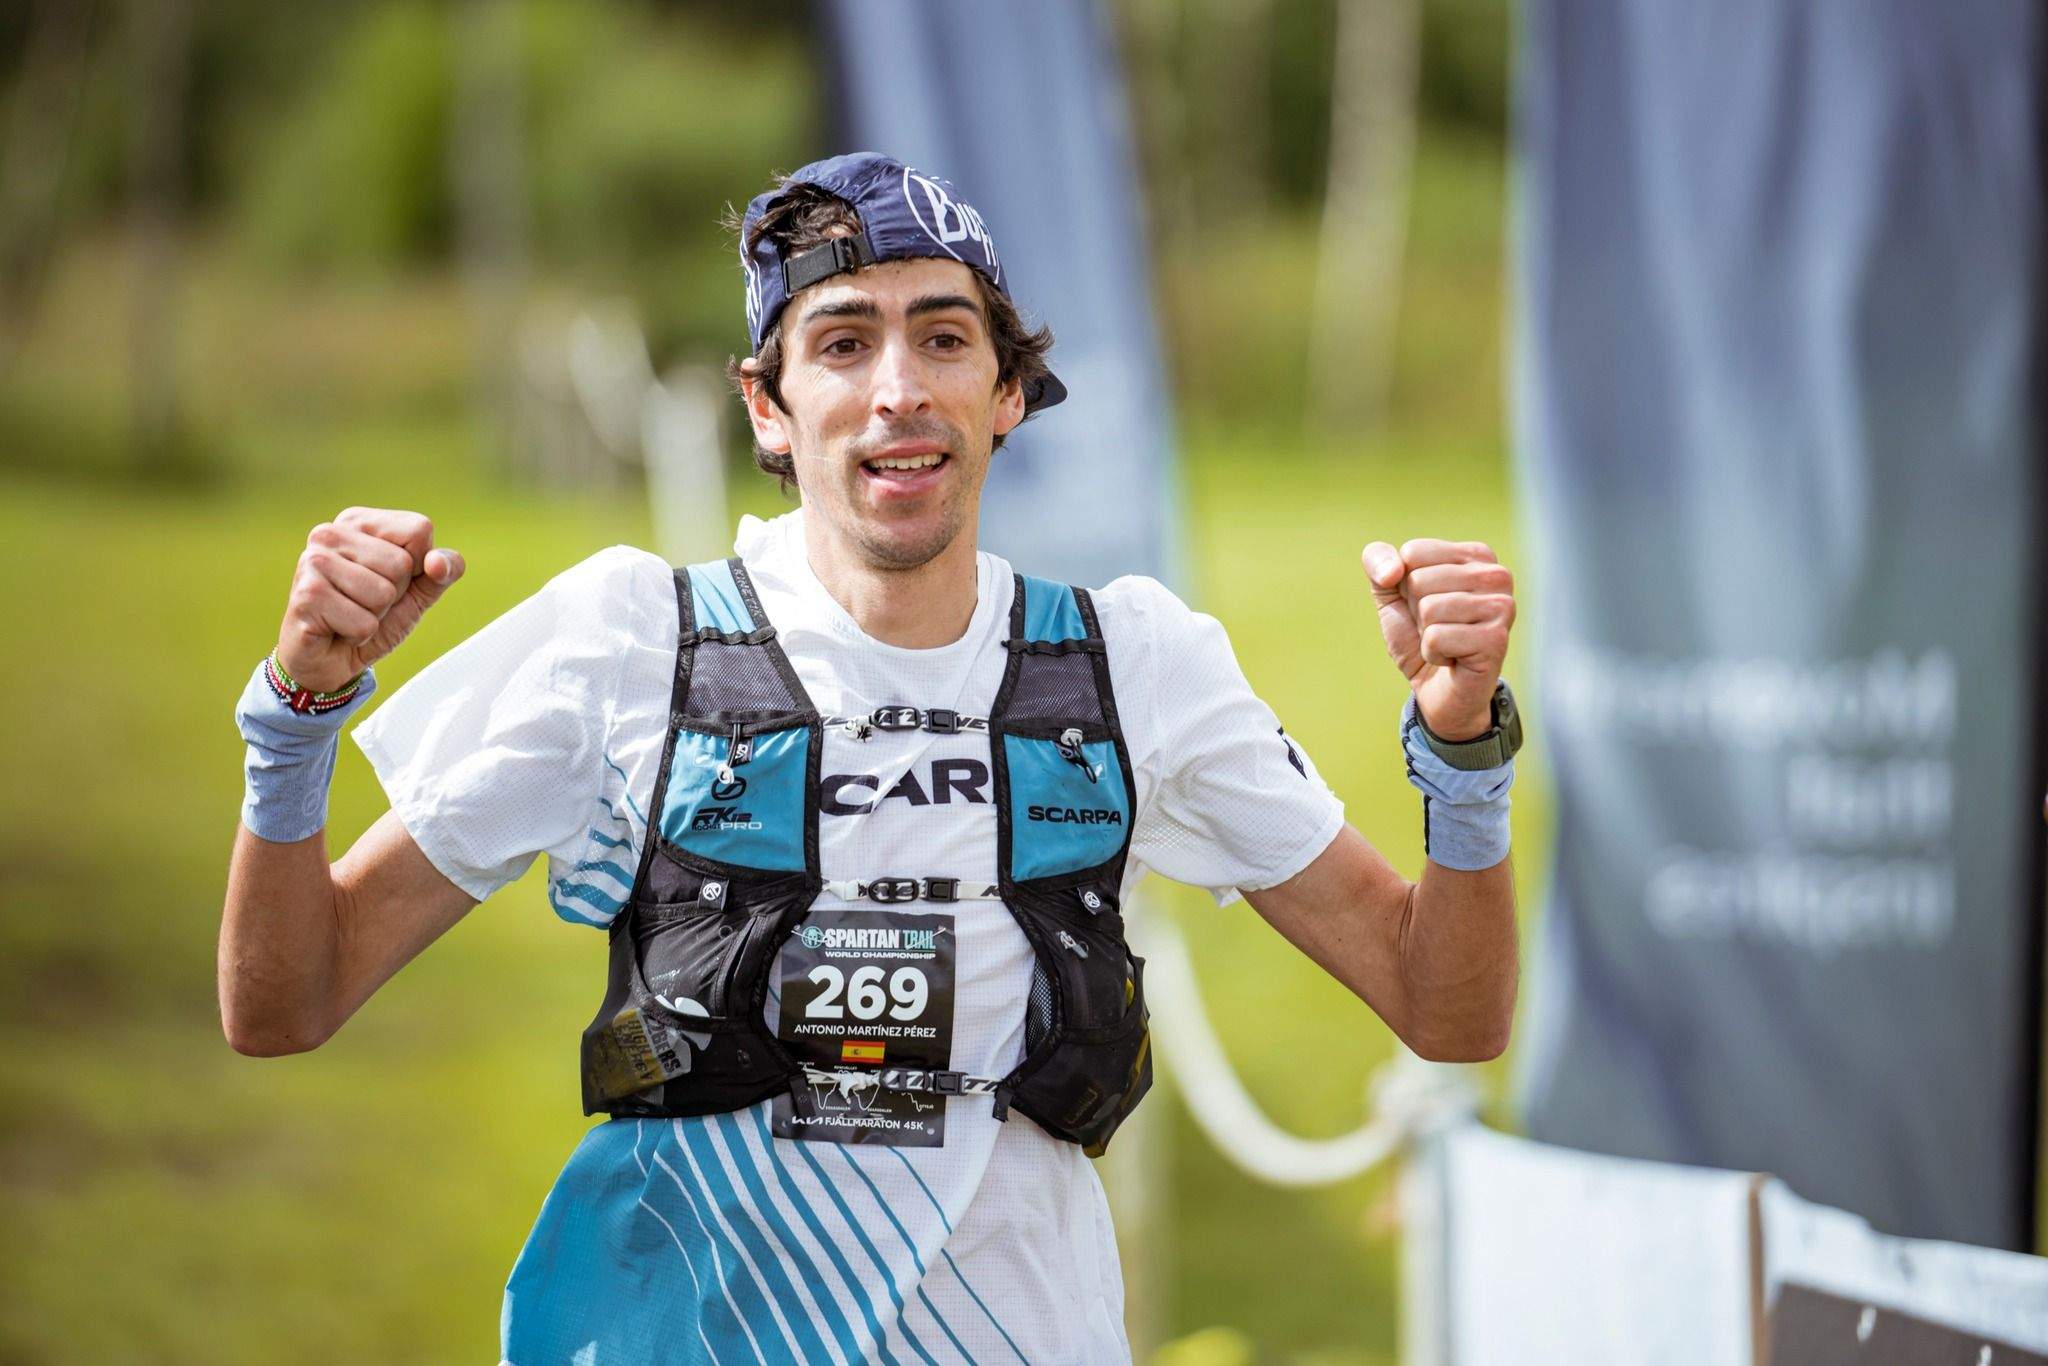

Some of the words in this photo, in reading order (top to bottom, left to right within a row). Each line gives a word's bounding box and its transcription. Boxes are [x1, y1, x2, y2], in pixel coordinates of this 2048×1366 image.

[819, 758, 997, 816] CAR
[1028, 806, 1122, 825] SCARPA
[721, 822, 762, 830] PRO
[825, 929, 900, 949] SPARTAN
[903, 929, 936, 950] TRAIL
[825, 951, 861, 959] WORLD
[862, 952, 936, 960] CHAMPIONSHIP
[805, 964, 929, 1022] 269
[794, 1024, 846, 1036] ANTONIO
[847, 1024, 902, 1037] MARTÍNEZ
[903, 1025, 937, 1038] PÉREZ
[903, 1119, 924, 1131] 45K
